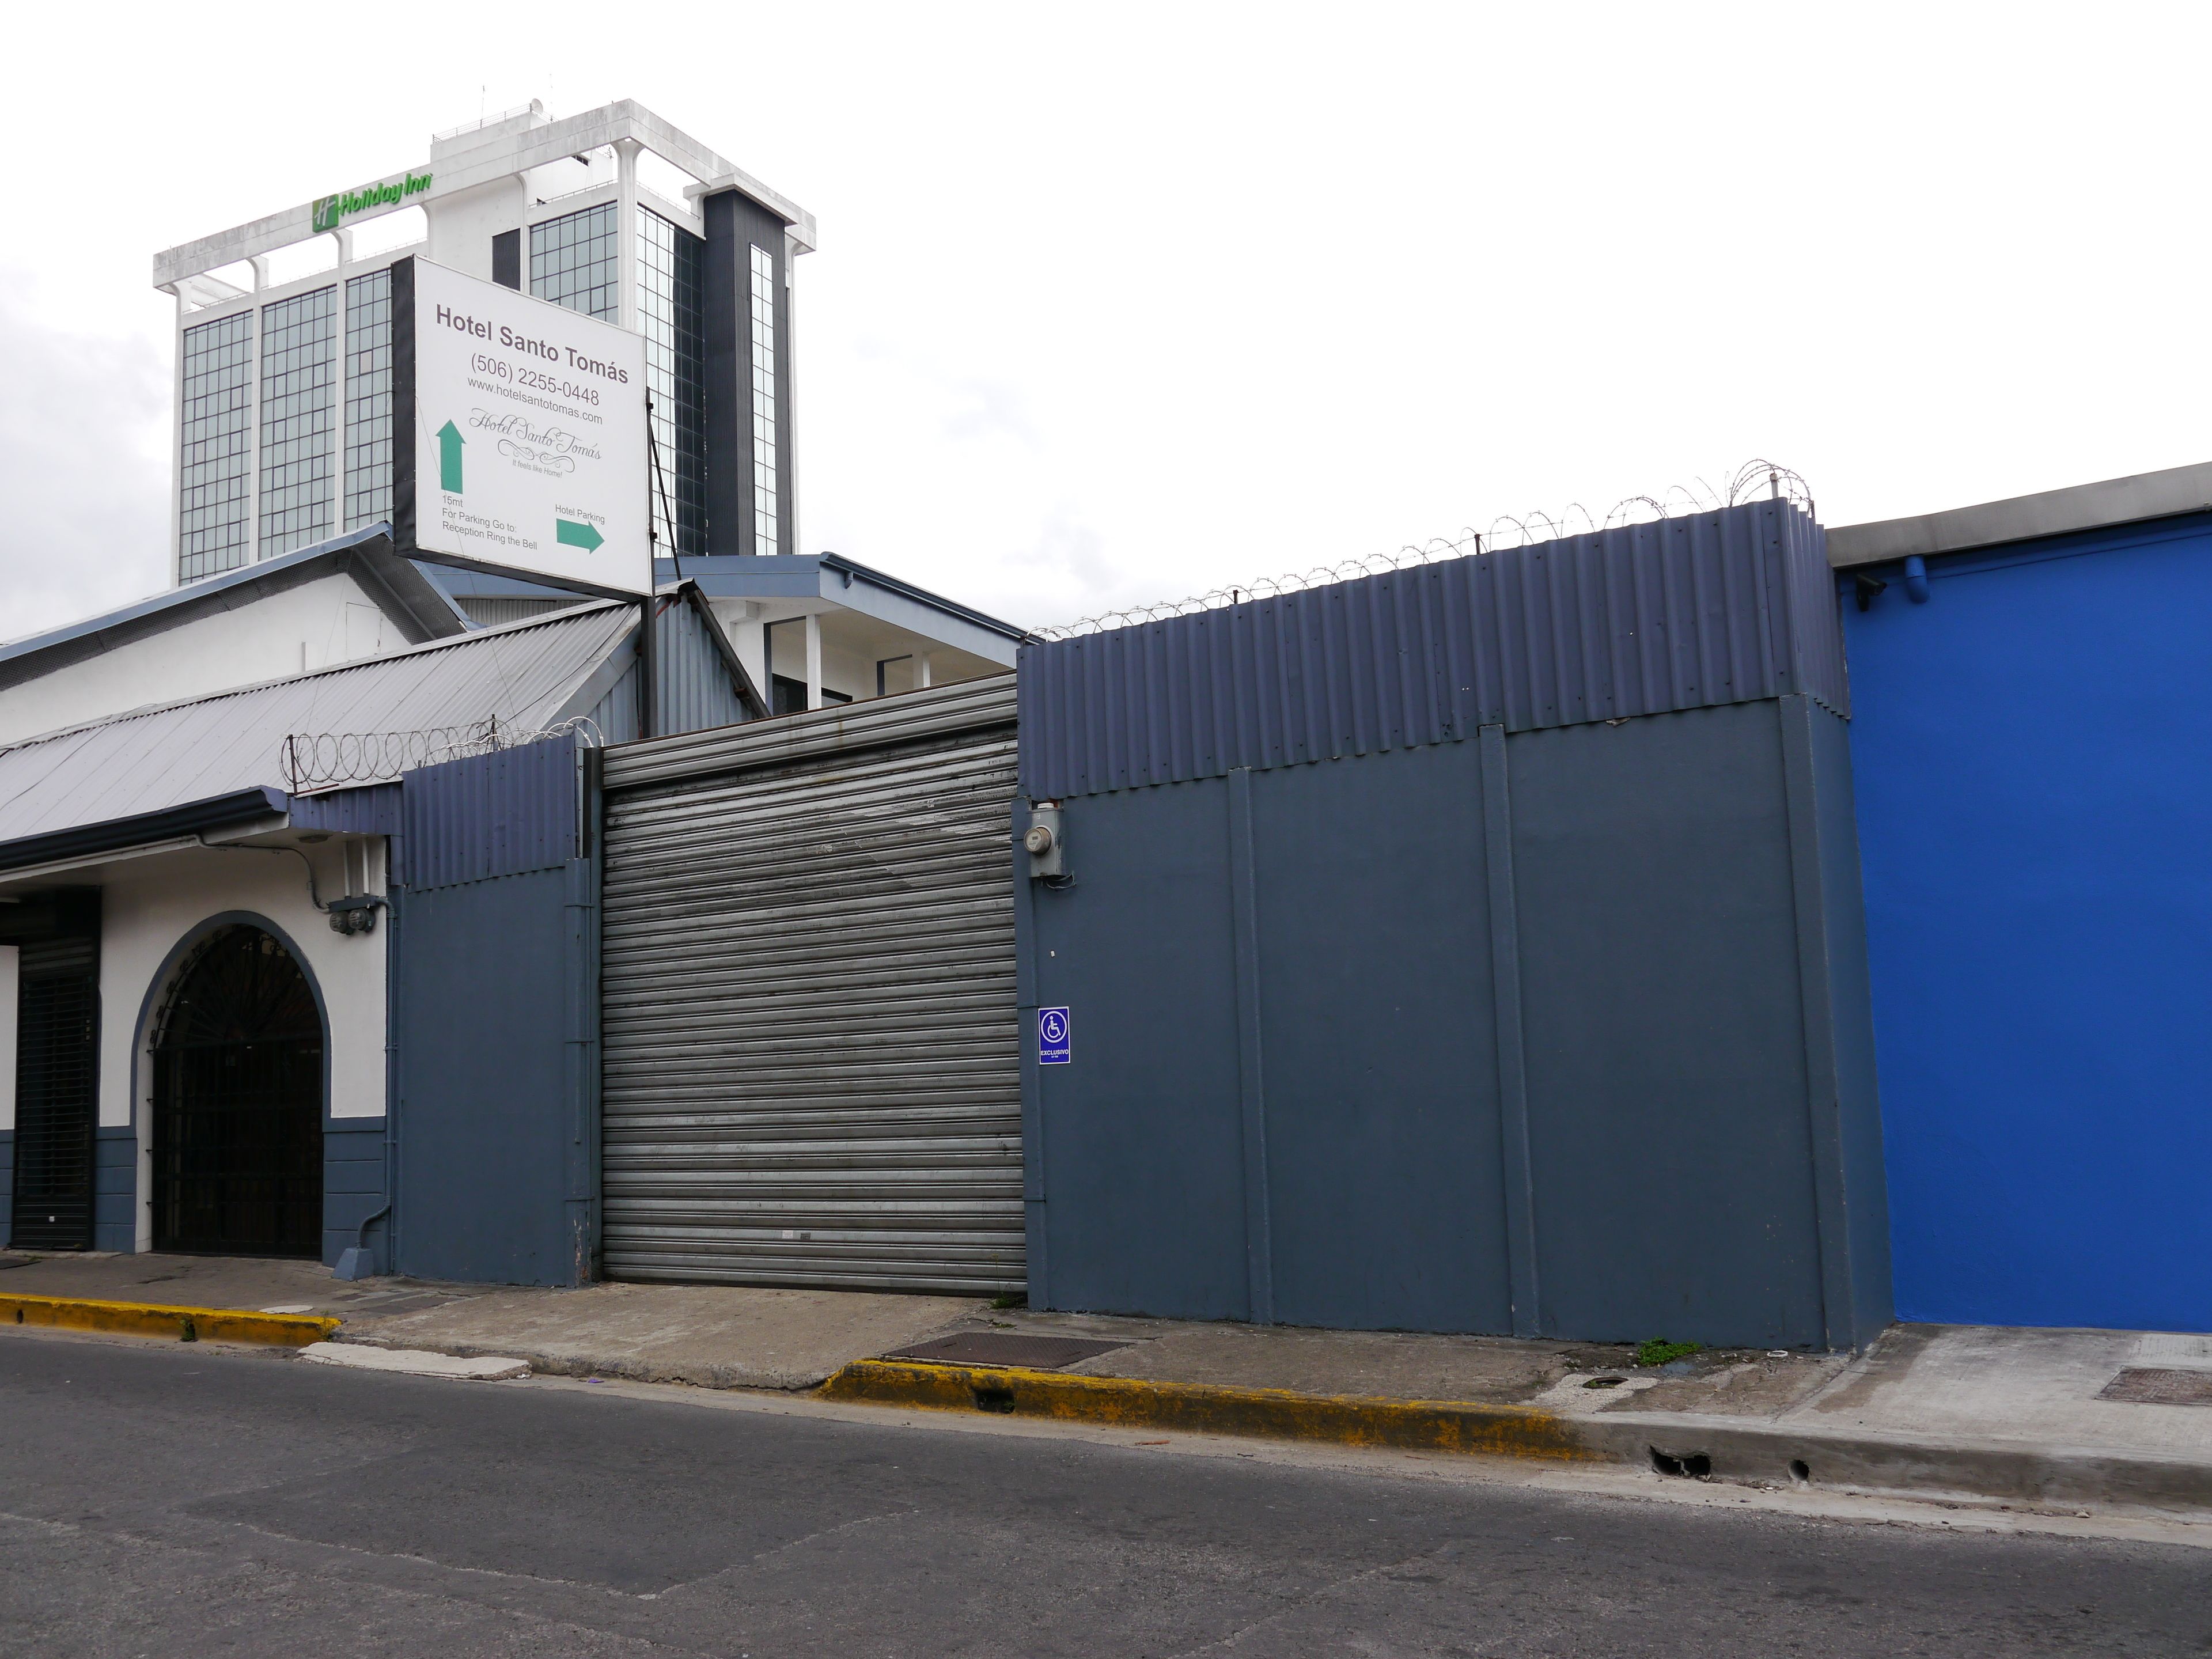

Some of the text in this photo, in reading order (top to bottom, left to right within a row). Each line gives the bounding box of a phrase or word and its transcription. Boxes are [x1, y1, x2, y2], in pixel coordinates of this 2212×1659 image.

[339, 173, 431, 217] Holiday Inn
[437, 304, 628, 384] Hotel Santo Tomás
[471, 353, 599, 406] (506) 2255-0448
[468, 377, 603, 425] www.hotelsantotomas.com
[469, 408, 601, 460] Hotel Santo Tomás
[518, 461, 531, 471] feels
[533, 465, 542, 474] like
[544, 468, 563, 479] Home!
[442, 495, 463, 507] 15mt
[555, 503, 605, 525] Hotel Parking
[442, 507, 517, 533] For Parking Go to:
[442, 521, 537, 550] Reception Ring the Bell
